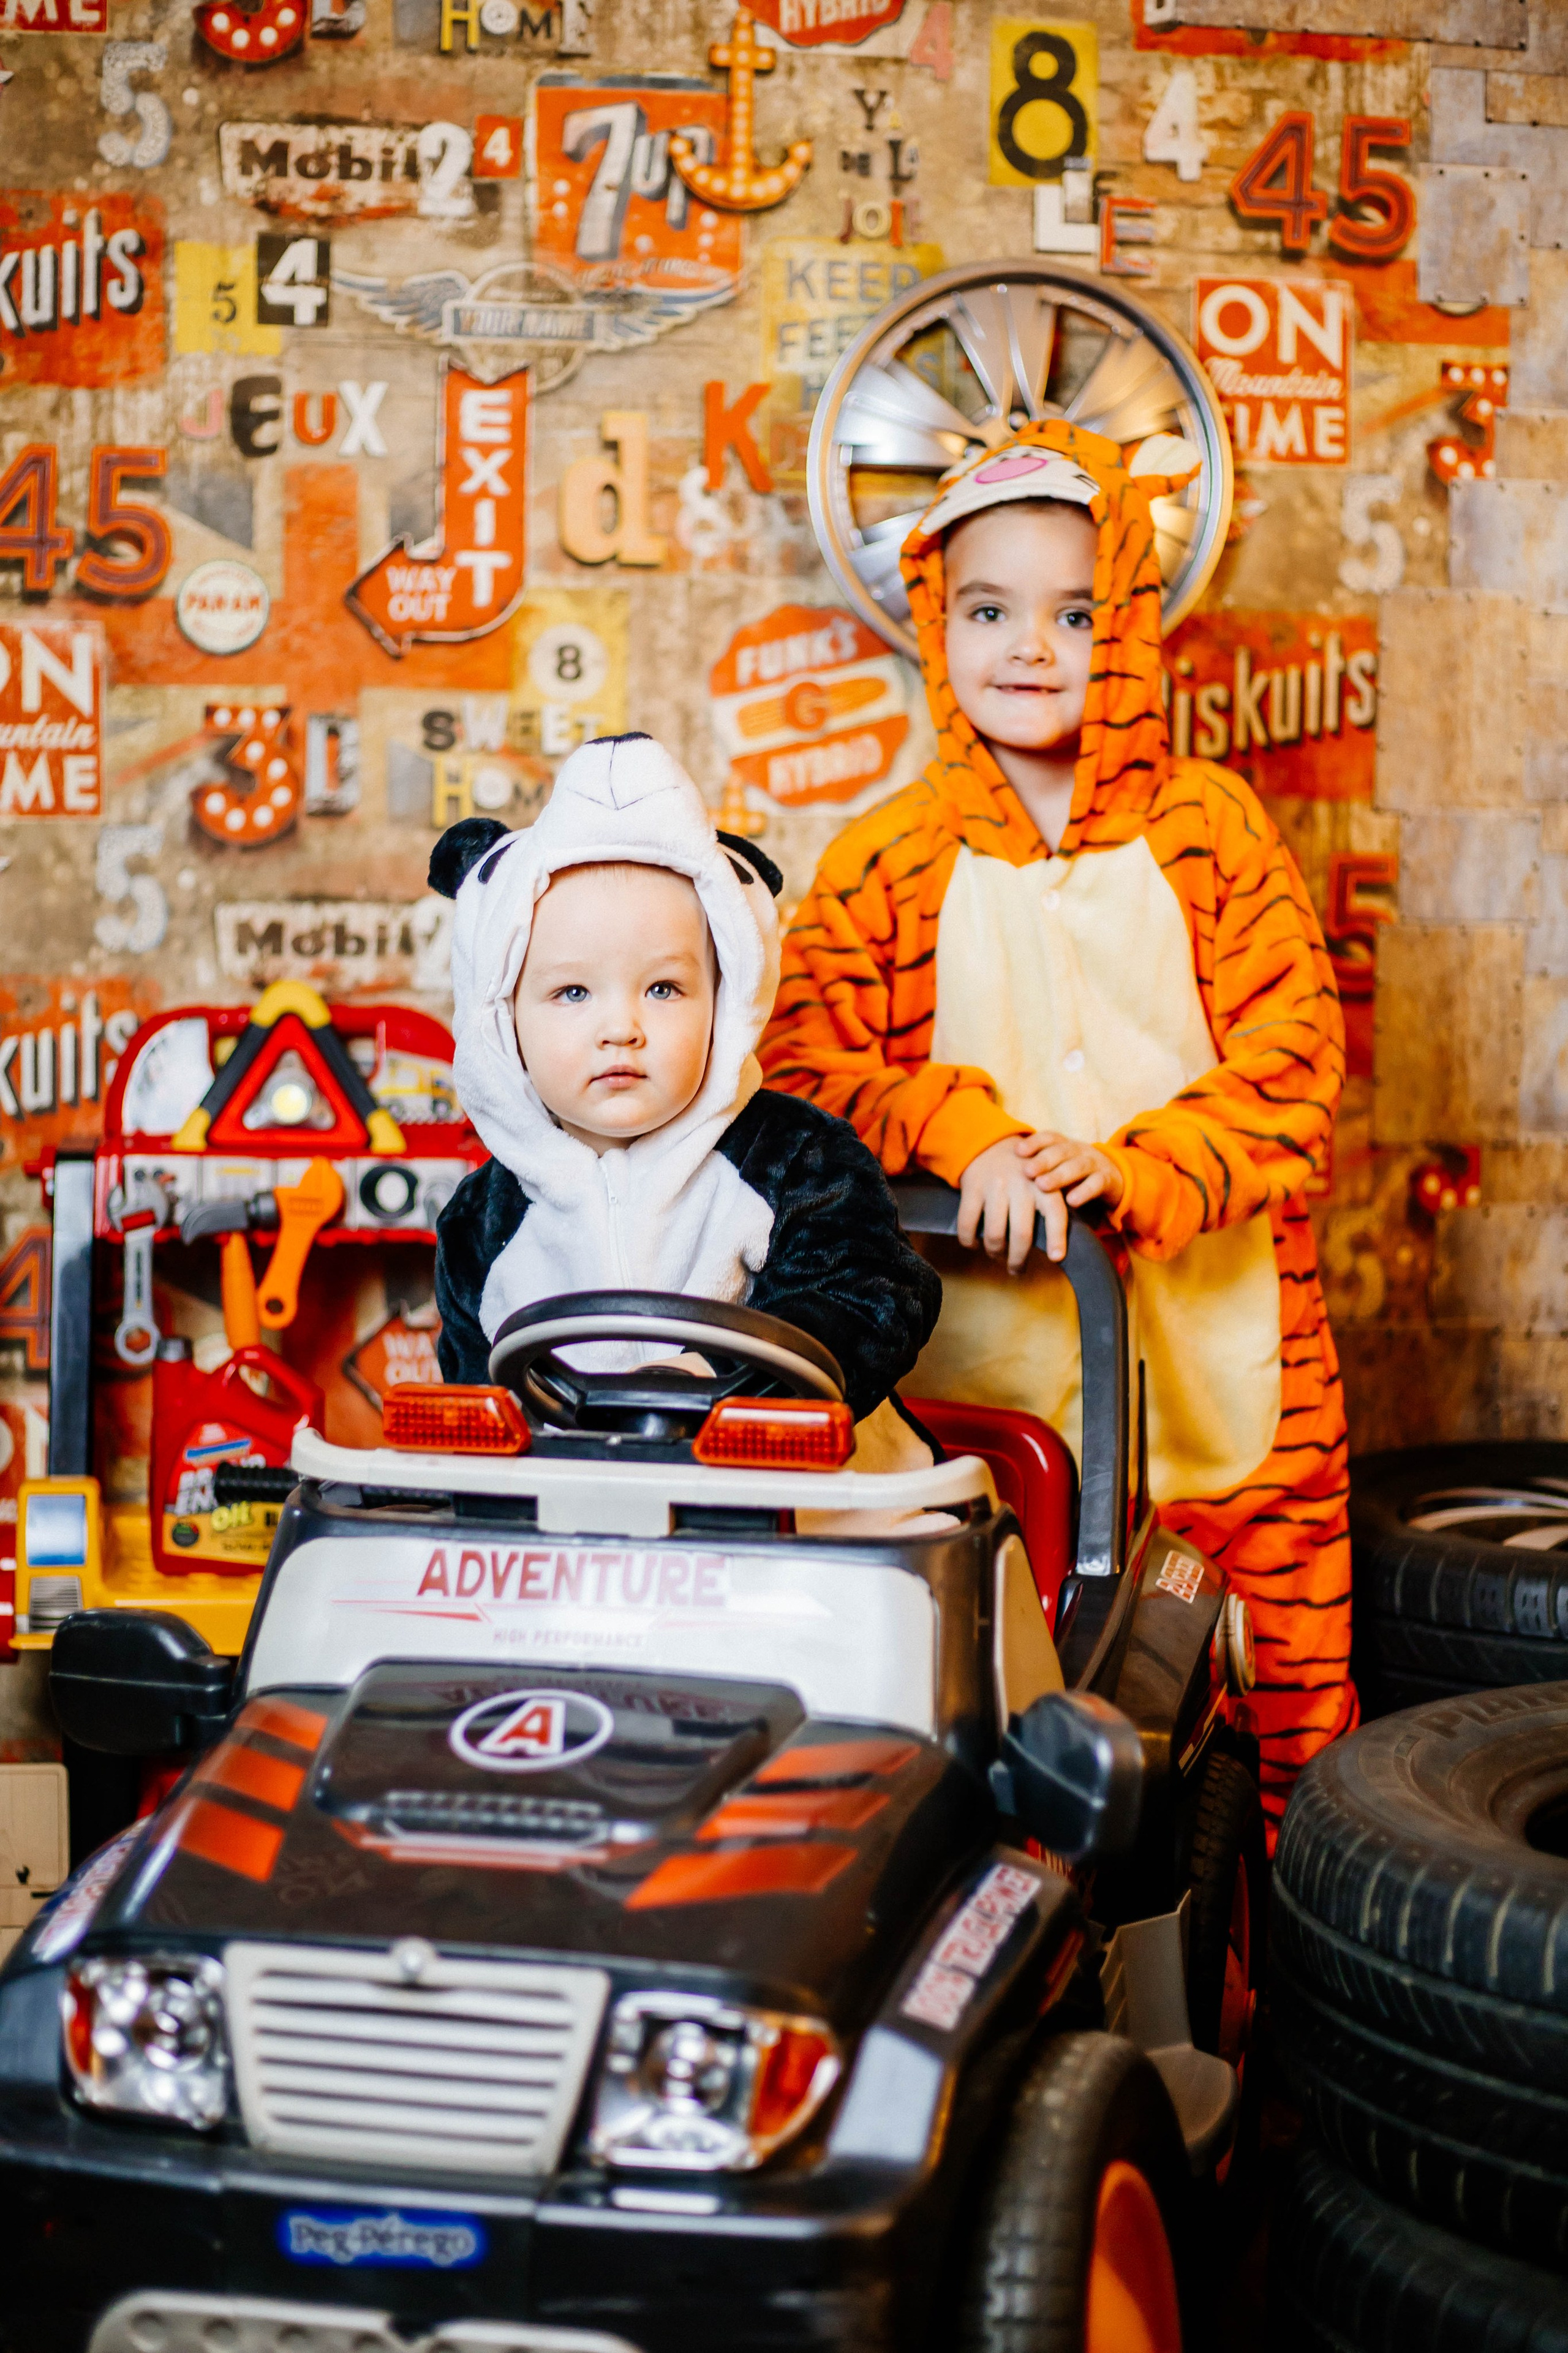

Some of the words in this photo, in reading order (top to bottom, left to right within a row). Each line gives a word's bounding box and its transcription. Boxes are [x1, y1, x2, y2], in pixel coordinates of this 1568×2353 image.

[98, 42, 171, 167] 5
[483, 126, 513, 167] 4
[997, 31, 1088, 179] 8
[1144, 71, 1205, 181] 4
[1229, 111, 1417, 260] 45
[212, 282, 238, 323] 5
[262, 238, 327, 325] 4
[776, 314, 875, 362] FEE
[1200, 284, 1343, 369] ON
[704, 380, 774, 494] K
[1223, 402, 1346, 458] IME
[0, 444, 172, 595] 45
[456, 390, 513, 608] EXIT
[1338, 474, 1406, 592] 5
[385, 565, 456, 592] WAY
[386, 592, 452, 622] OUT
[0, 631, 92, 719] N
[557, 644, 583, 682] 8
[1163, 630, 1378, 761] iskuits
[95, 825, 170, 954] 5
[417, 1548, 727, 1607] ADVENTURE
[493, 1629, 529, 1645] HIGH
[478, 1698, 566, 1756] A
